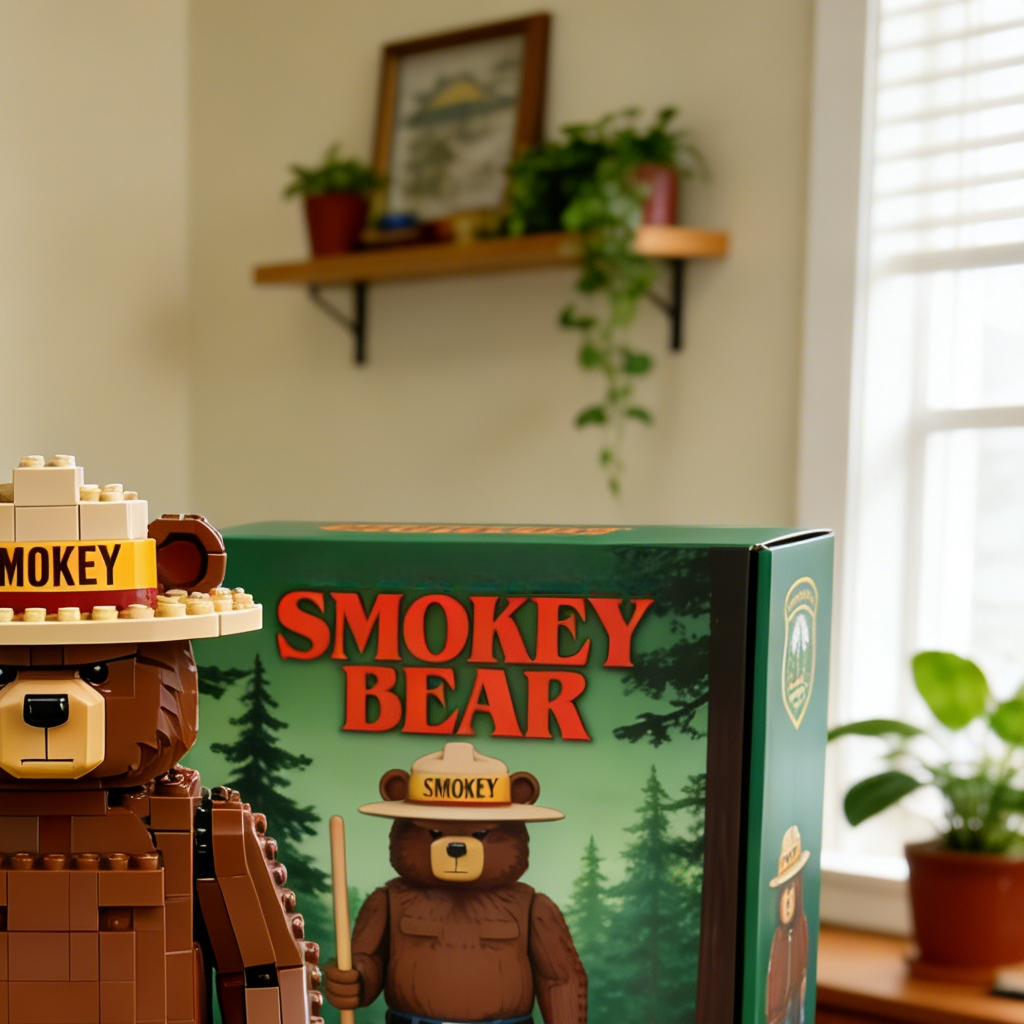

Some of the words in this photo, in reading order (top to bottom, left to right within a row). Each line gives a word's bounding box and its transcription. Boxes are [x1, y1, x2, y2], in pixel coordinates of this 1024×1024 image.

[277, 591, 654, 668] SMOKEY
[341, 665, 592, 741] BEAR
[423, 777, 498, 799] SMOKEY
